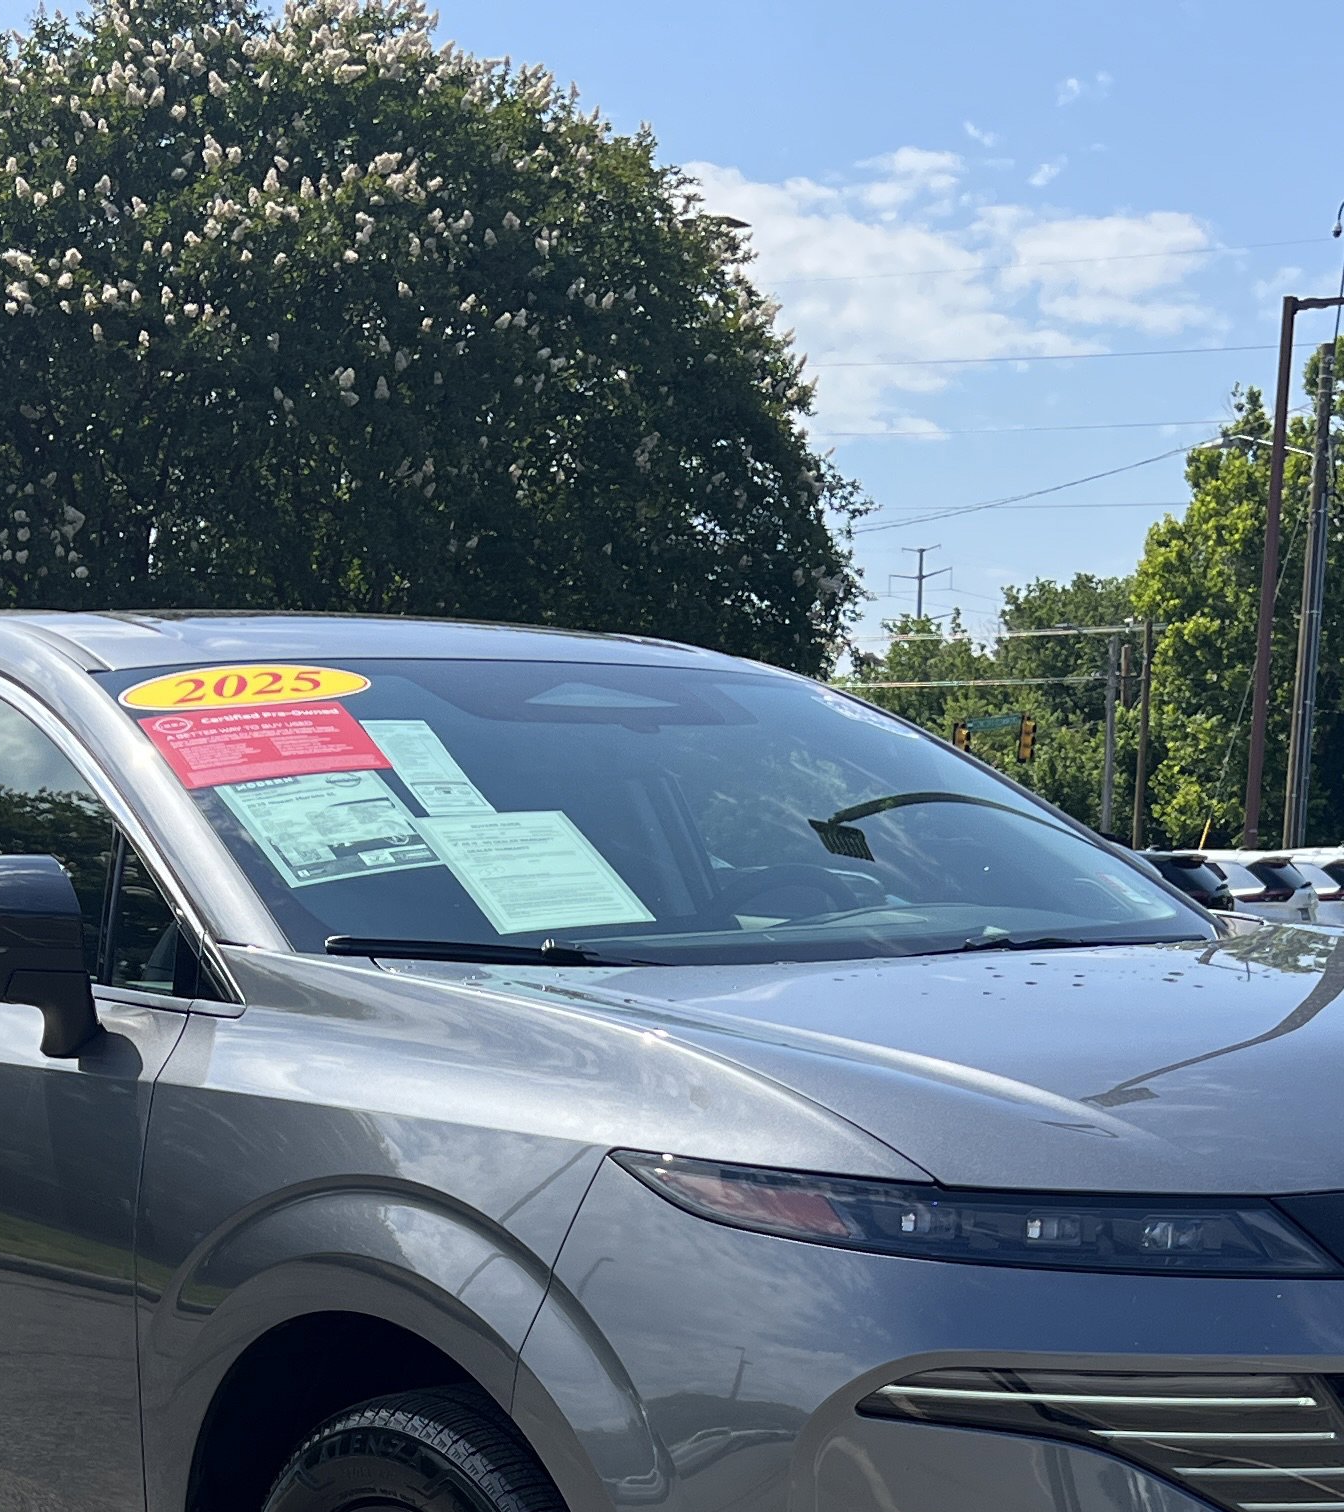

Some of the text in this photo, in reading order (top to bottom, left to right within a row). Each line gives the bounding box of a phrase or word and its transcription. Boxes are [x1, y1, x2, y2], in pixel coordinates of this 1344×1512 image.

[174, 670, 322, 704] 2025
[200, 707, 340, 725] Certified Pre-Owned
[219, 726, 242, 735] WAY
[243, 724, 260, 732] TO
[235, 777, 294, 792] MODERN
